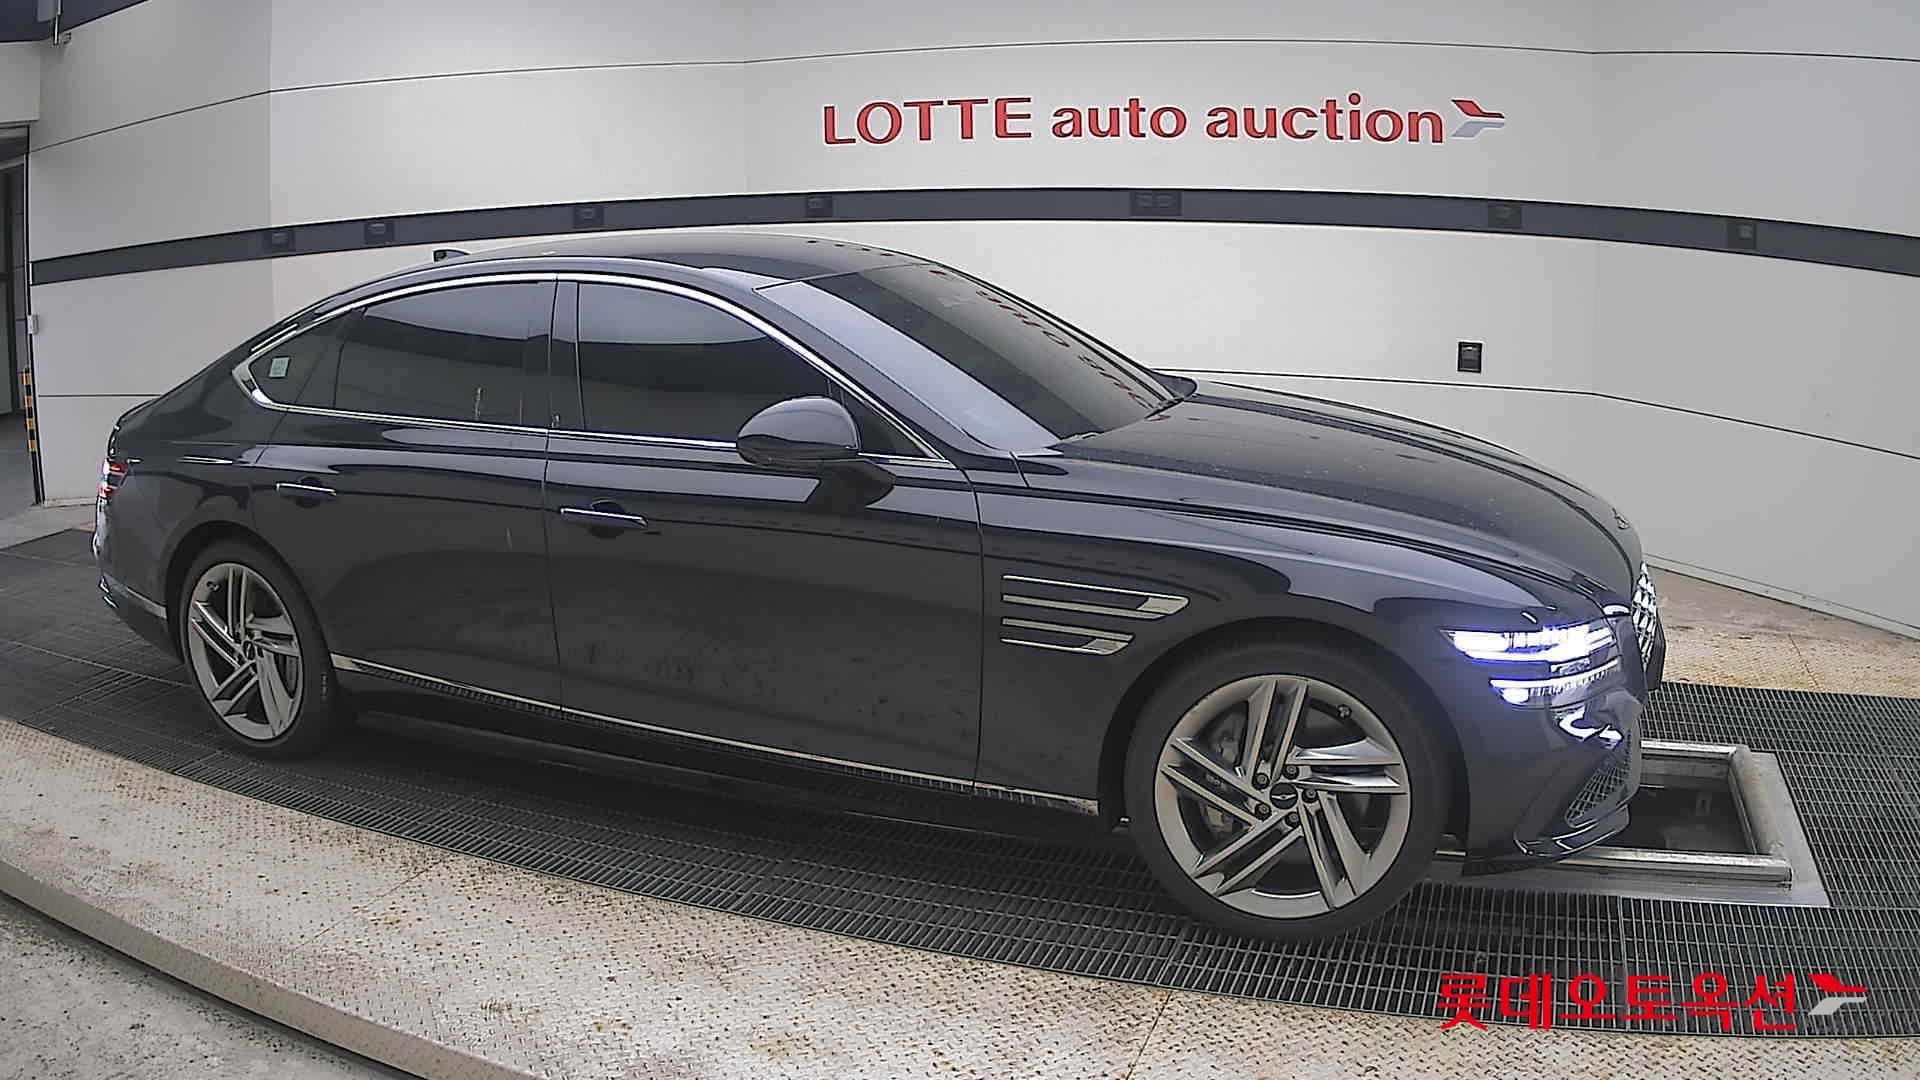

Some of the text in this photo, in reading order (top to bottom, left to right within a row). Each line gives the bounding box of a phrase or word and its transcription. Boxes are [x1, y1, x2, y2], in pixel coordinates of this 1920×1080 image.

[823, 92, 1446, 146] LOTTE auto auction
